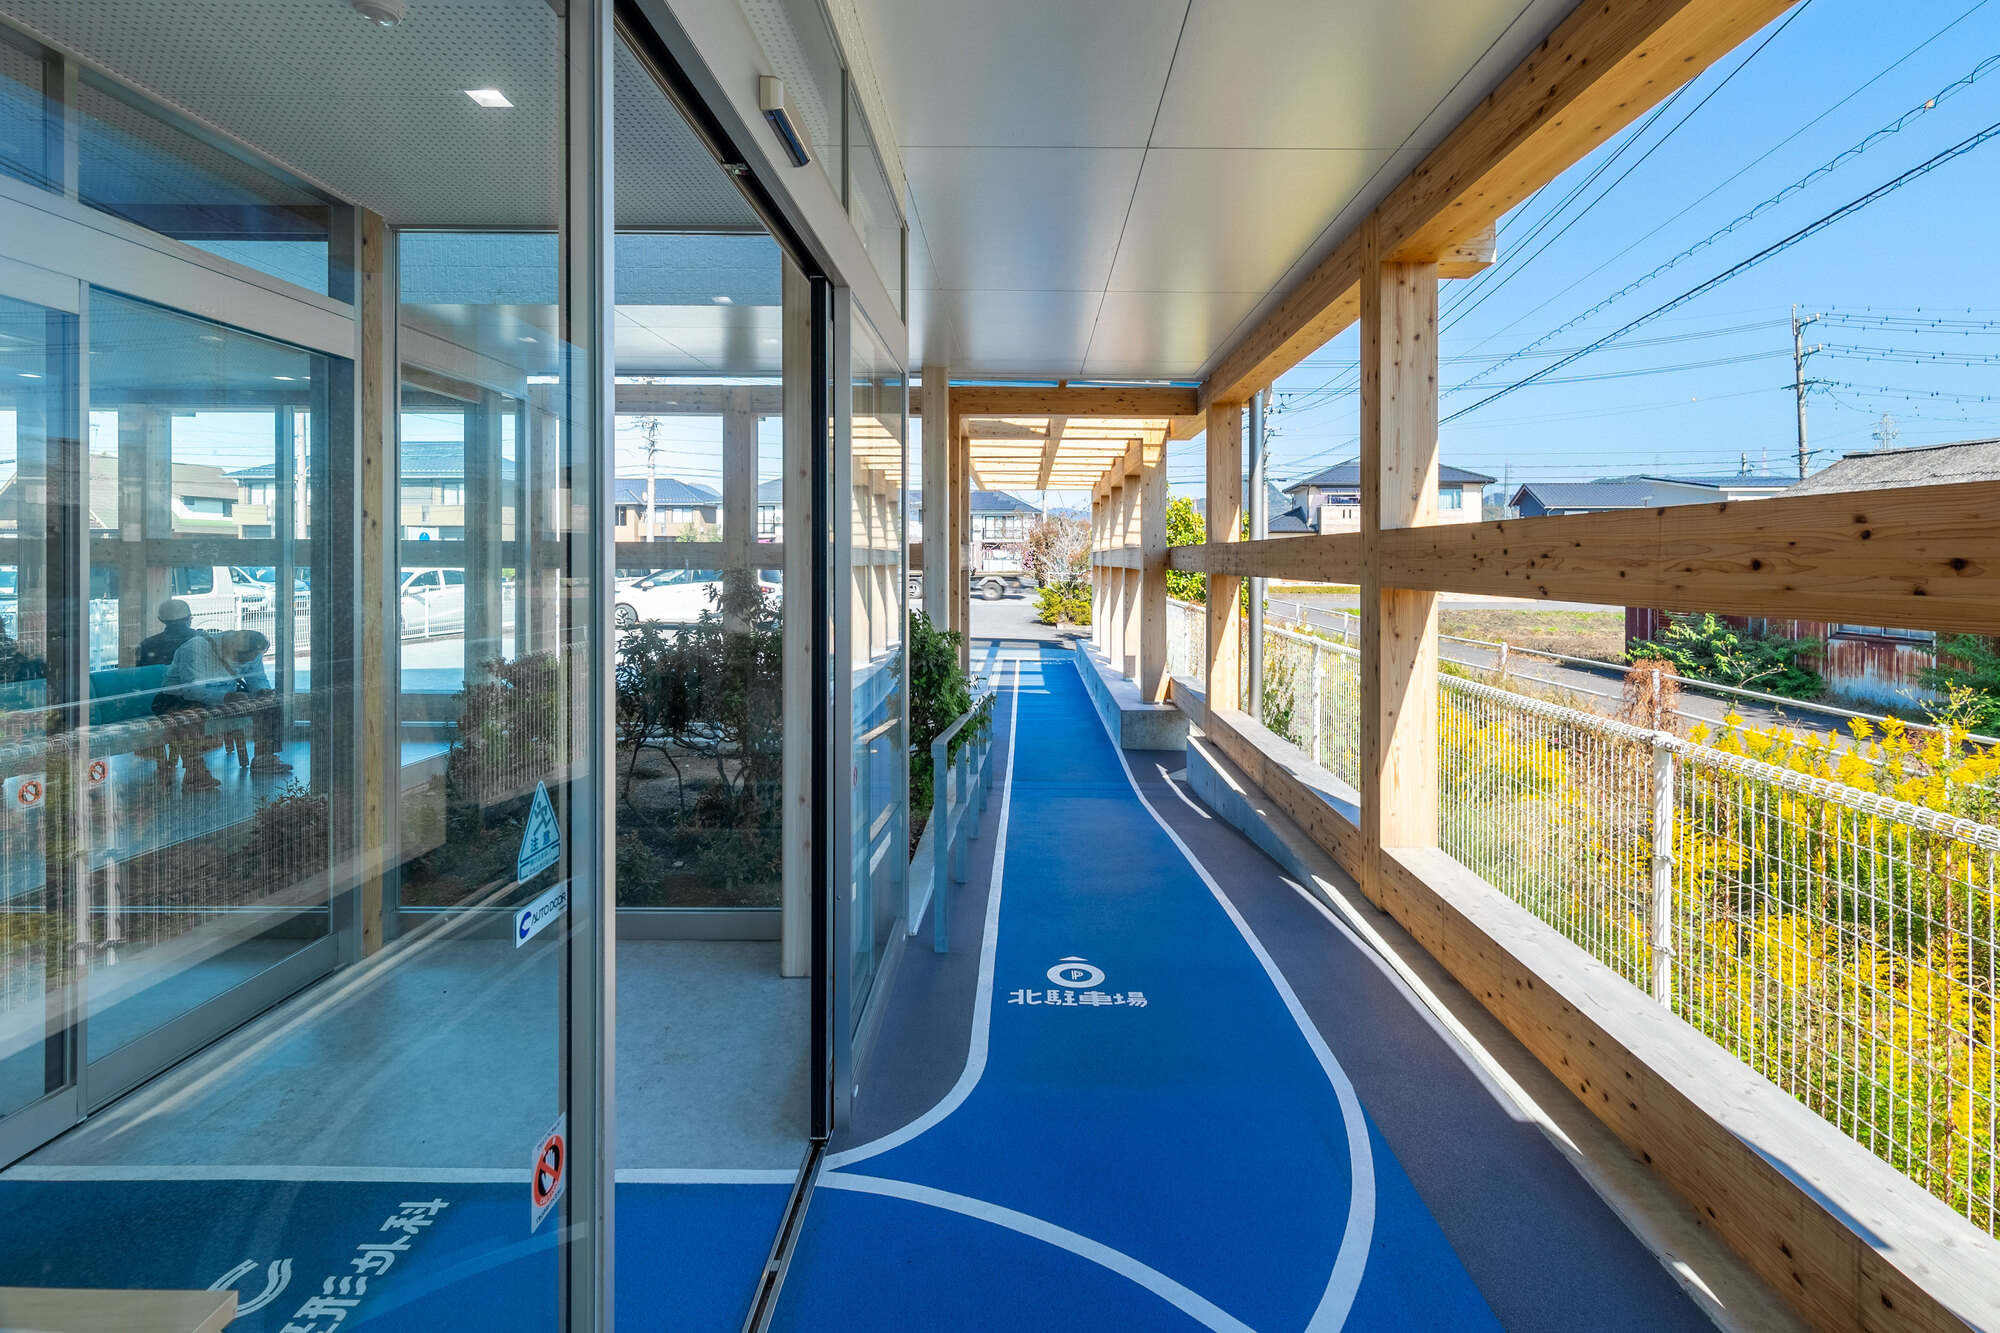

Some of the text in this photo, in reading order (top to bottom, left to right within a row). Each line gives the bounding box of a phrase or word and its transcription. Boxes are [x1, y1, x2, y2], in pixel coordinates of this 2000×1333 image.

[530, 831, 550, 852] 注意
[531, 891, 567, 925] AUTO DOOR
[1007, 988, 1148, 1008] 北駐車場
[279, 1198, 450, 1333] 形外科
